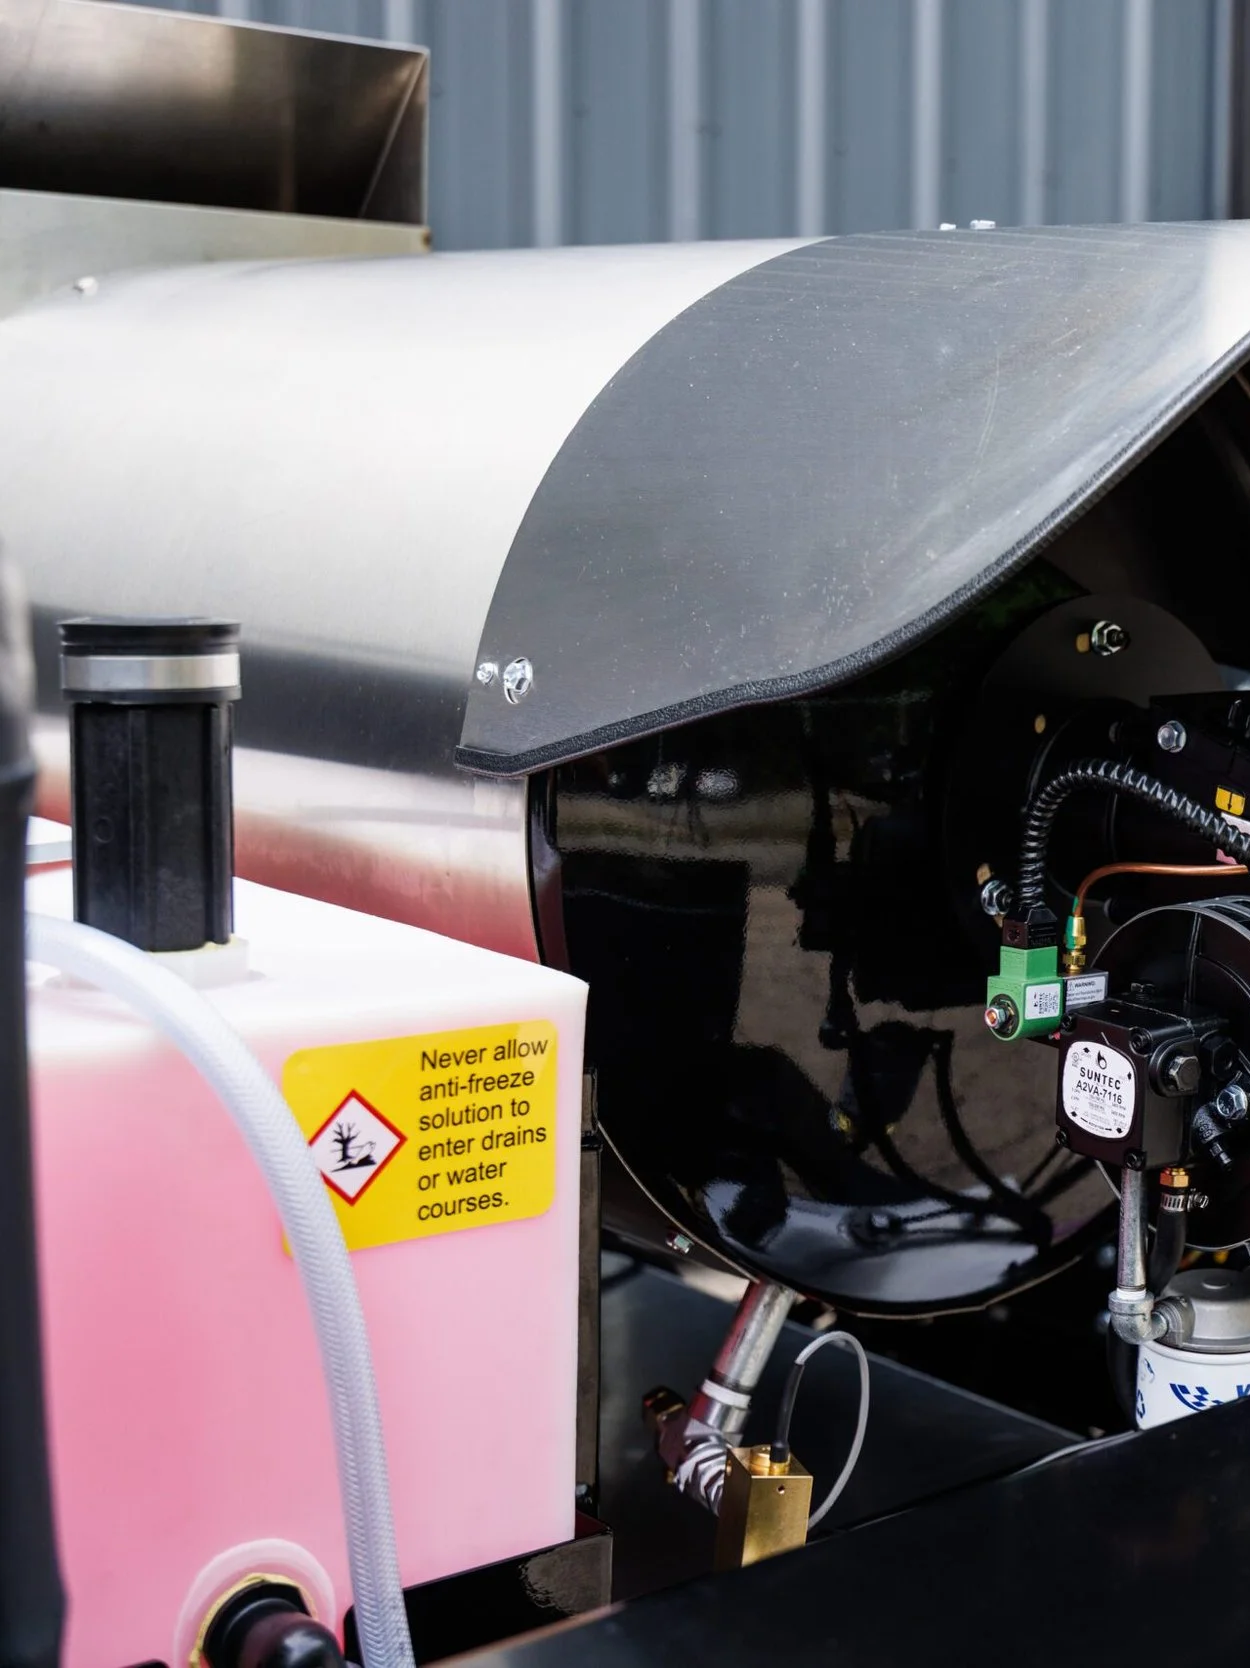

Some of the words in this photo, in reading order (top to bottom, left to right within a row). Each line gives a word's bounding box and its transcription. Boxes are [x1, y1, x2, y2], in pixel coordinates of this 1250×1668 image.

[421, 1047, 487, 1071] Never
[493, 1039, 549, 1062] allow
[419, 1069, 535, 1102] anti-freeze
[1076, 1080, 1122, 1104] A2VA-7116
[1080, 1067, 1121, 1090] SUNTEC
[418, 1103, 503, 1132] solution
[511, 1098, 530, 1117] to
[418, 1137, 475, 1161] enter
[481, 1125, 547, 1151] drains
[417, 1172, 440, 1191] or
[446, 1161, 507, 1186] water
[417, 1191, 509, 1221] courses.
